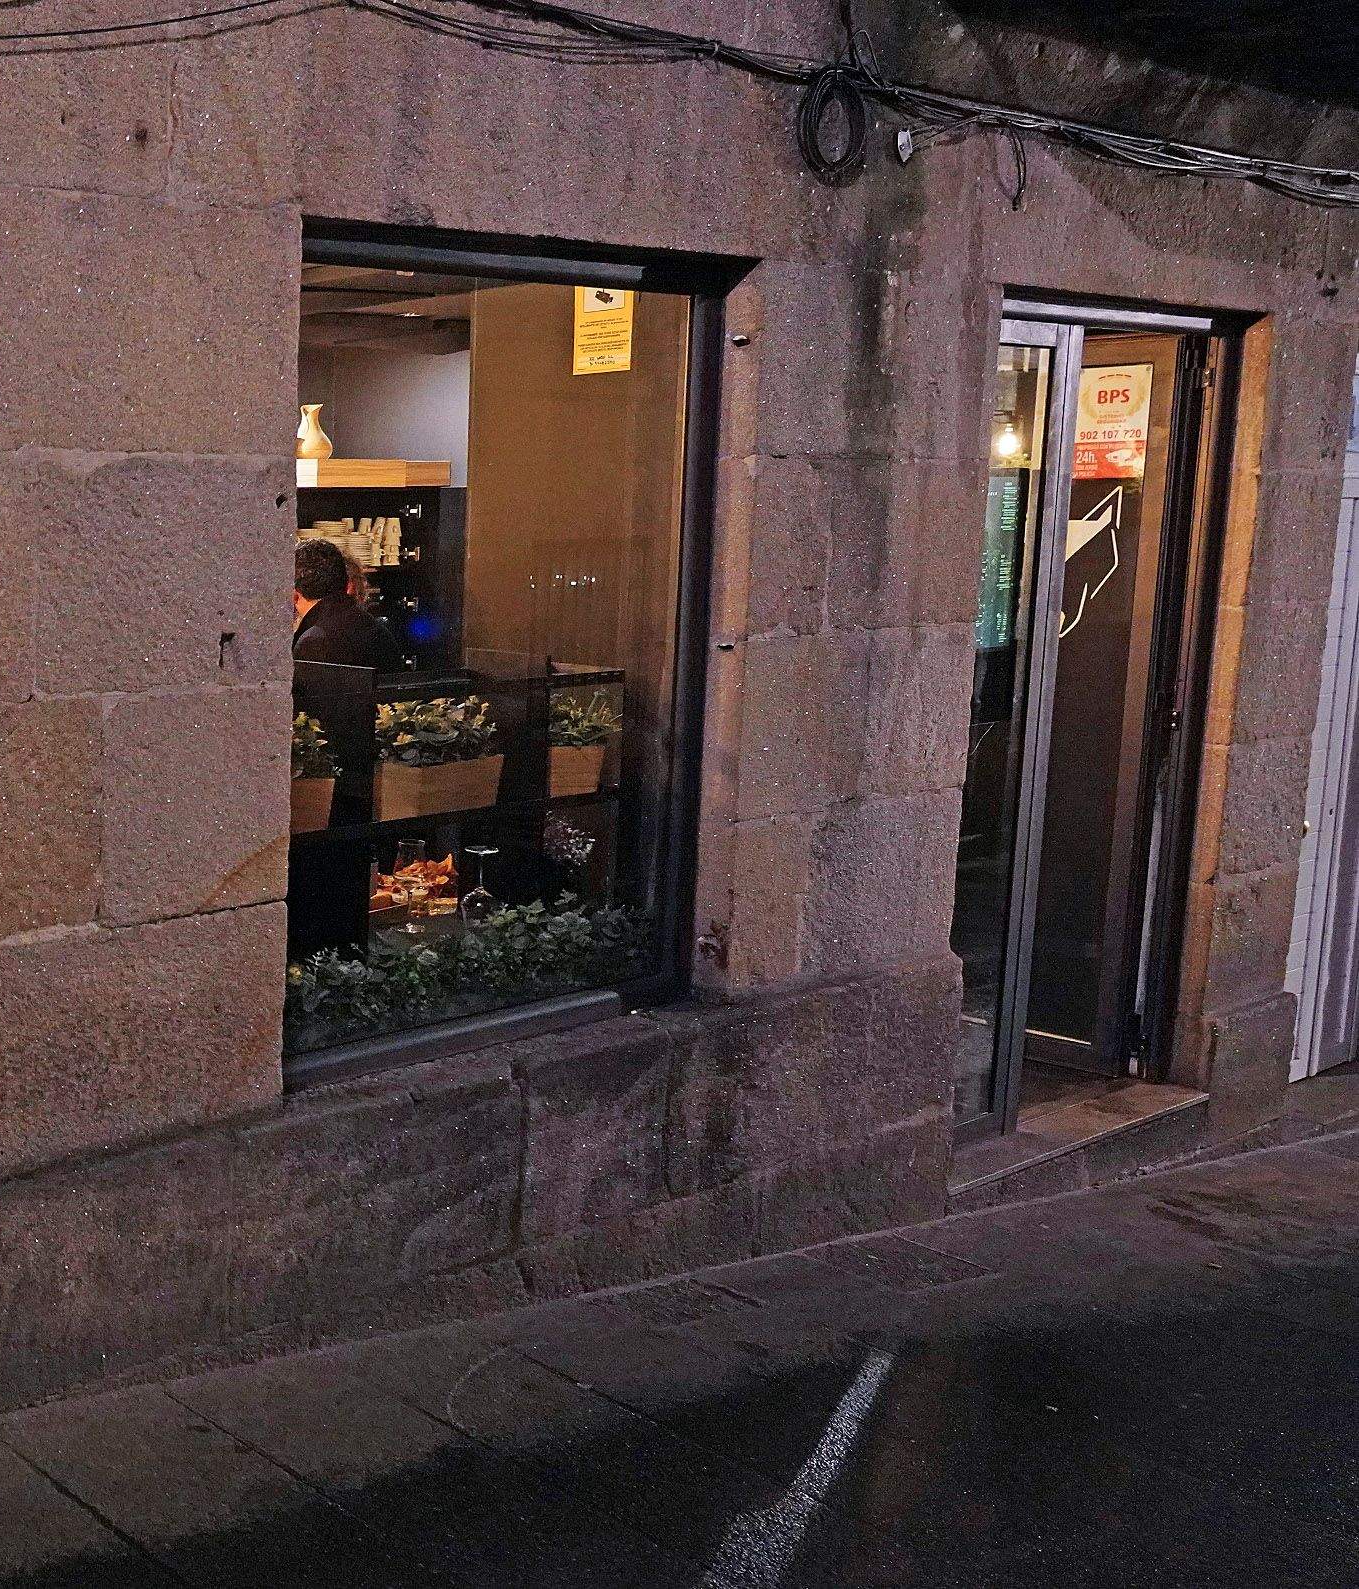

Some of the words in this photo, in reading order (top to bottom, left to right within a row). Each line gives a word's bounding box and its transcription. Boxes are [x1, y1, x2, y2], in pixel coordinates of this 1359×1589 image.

[1097, 389, 1130, 404] BPS
[1080, 431, 1098, 440] 902
[1102, 430, 1119, 439] 107
[1076, 451, 1098, 464] 24h.
